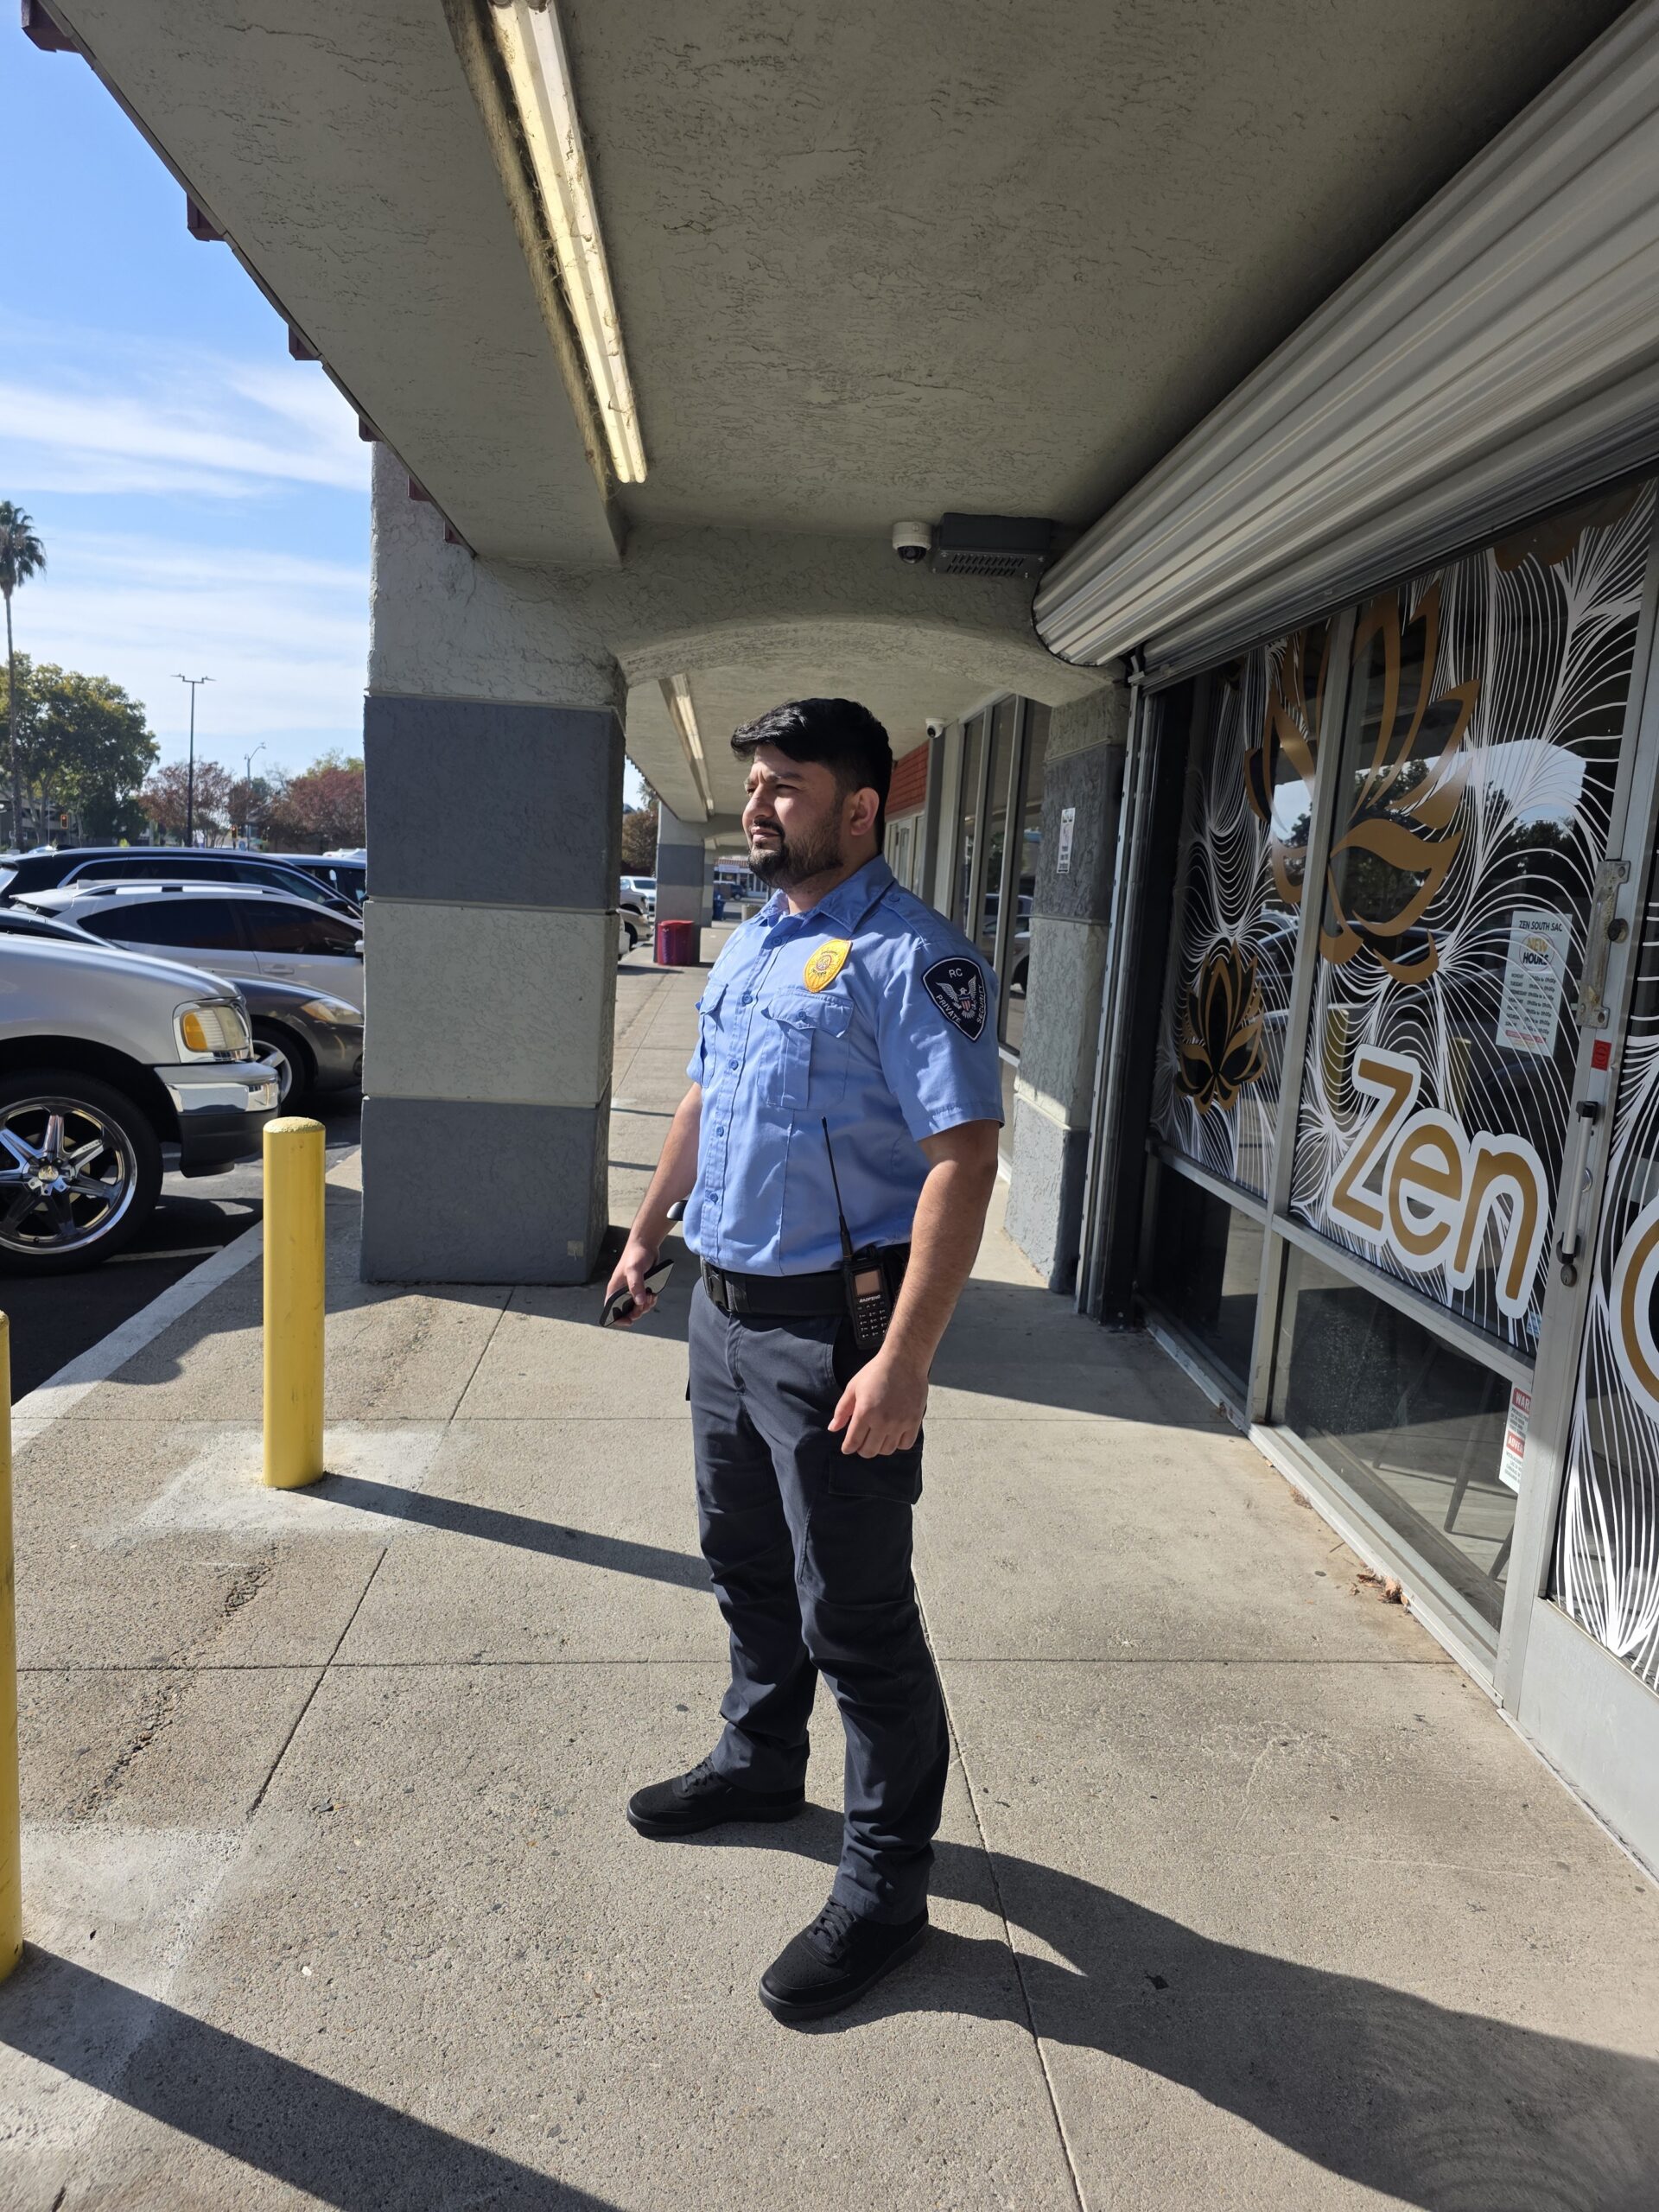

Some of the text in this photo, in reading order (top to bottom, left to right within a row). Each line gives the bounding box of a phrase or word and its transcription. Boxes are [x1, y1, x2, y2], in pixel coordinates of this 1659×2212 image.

[1519, 920, 1562, 931] ZEN SOUTH SAC
[1527, 937, 1548, 953] NEW
[1522, 951, 1548, 965] HOURS
[948, 968, 963, 978] RC
[936, 995, 961, 1023] PRIVATE
[1332, 1056, 1539, 1302] Zen
